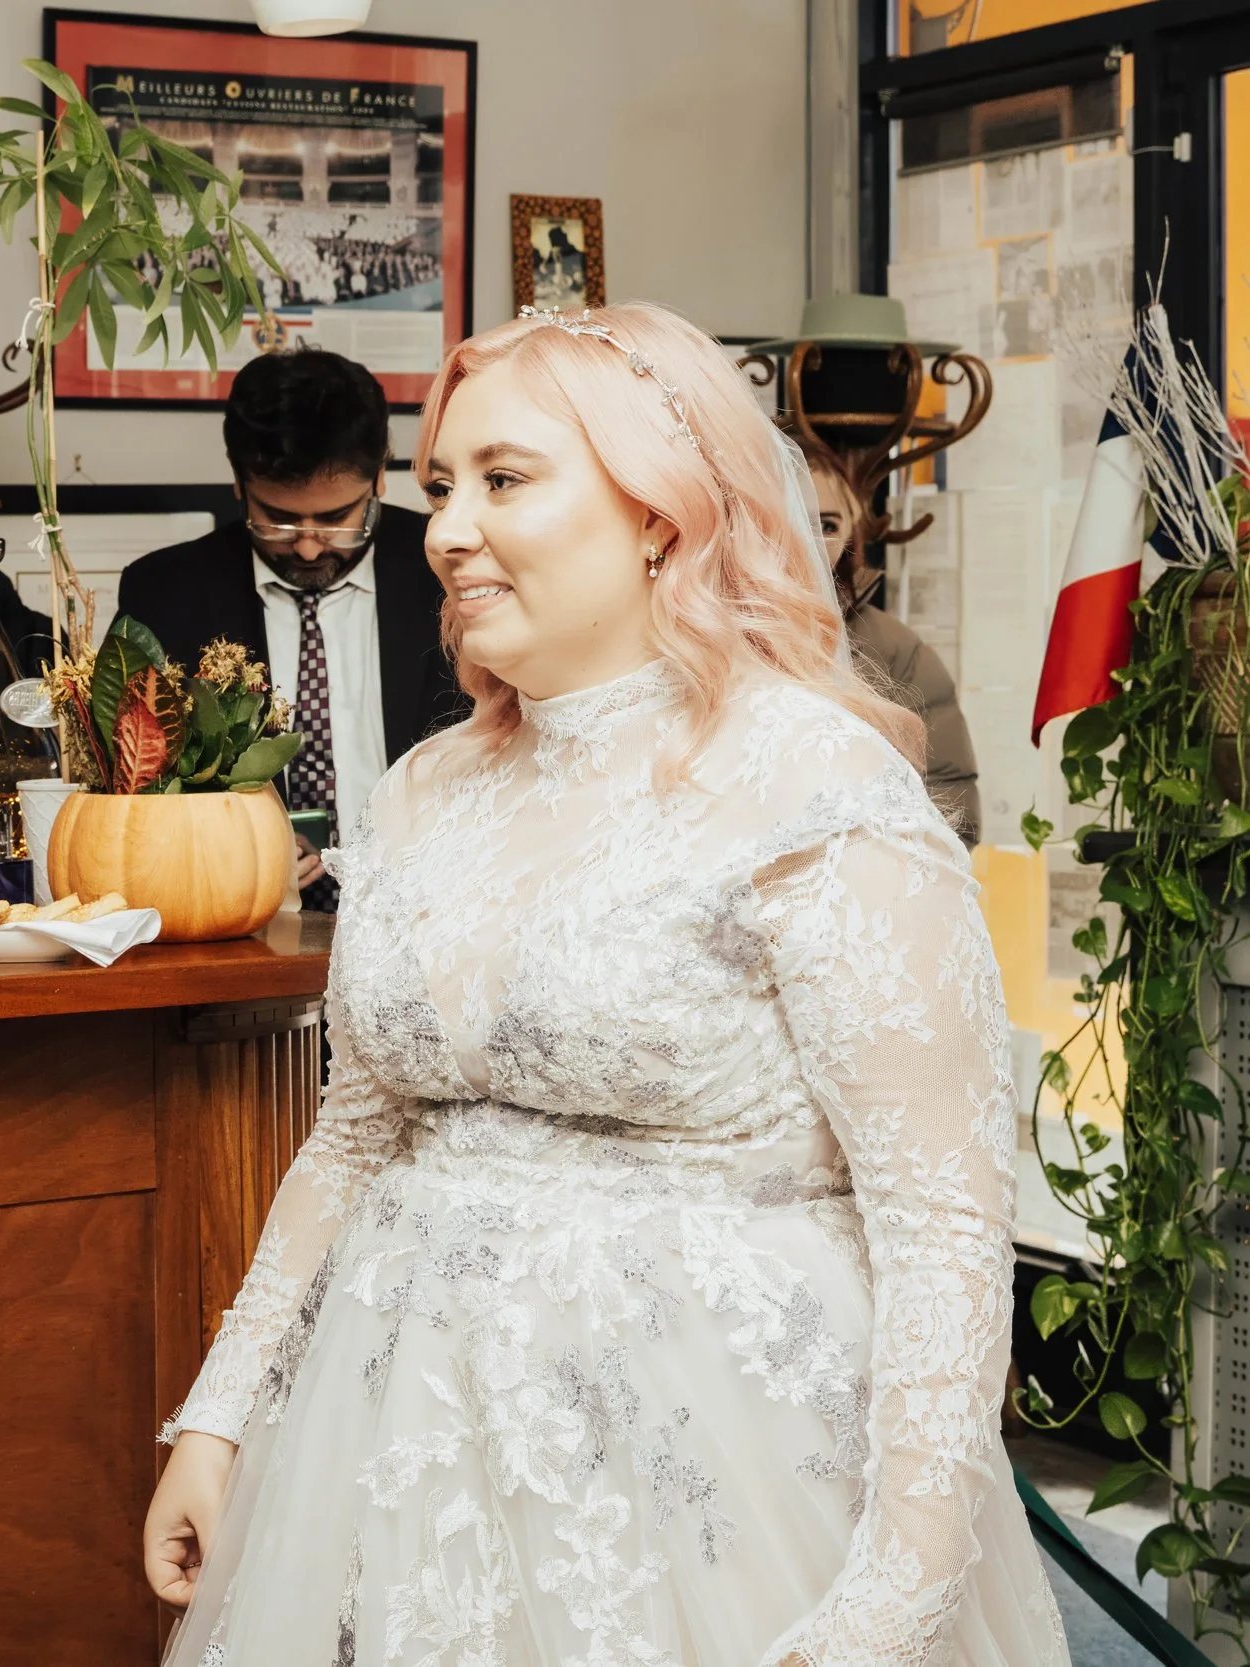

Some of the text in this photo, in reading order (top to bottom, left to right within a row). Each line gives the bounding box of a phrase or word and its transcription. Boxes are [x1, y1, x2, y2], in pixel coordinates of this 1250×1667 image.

[116, 74, 417, 108] MEILLEURS OUVRIERS DE FRANCE
